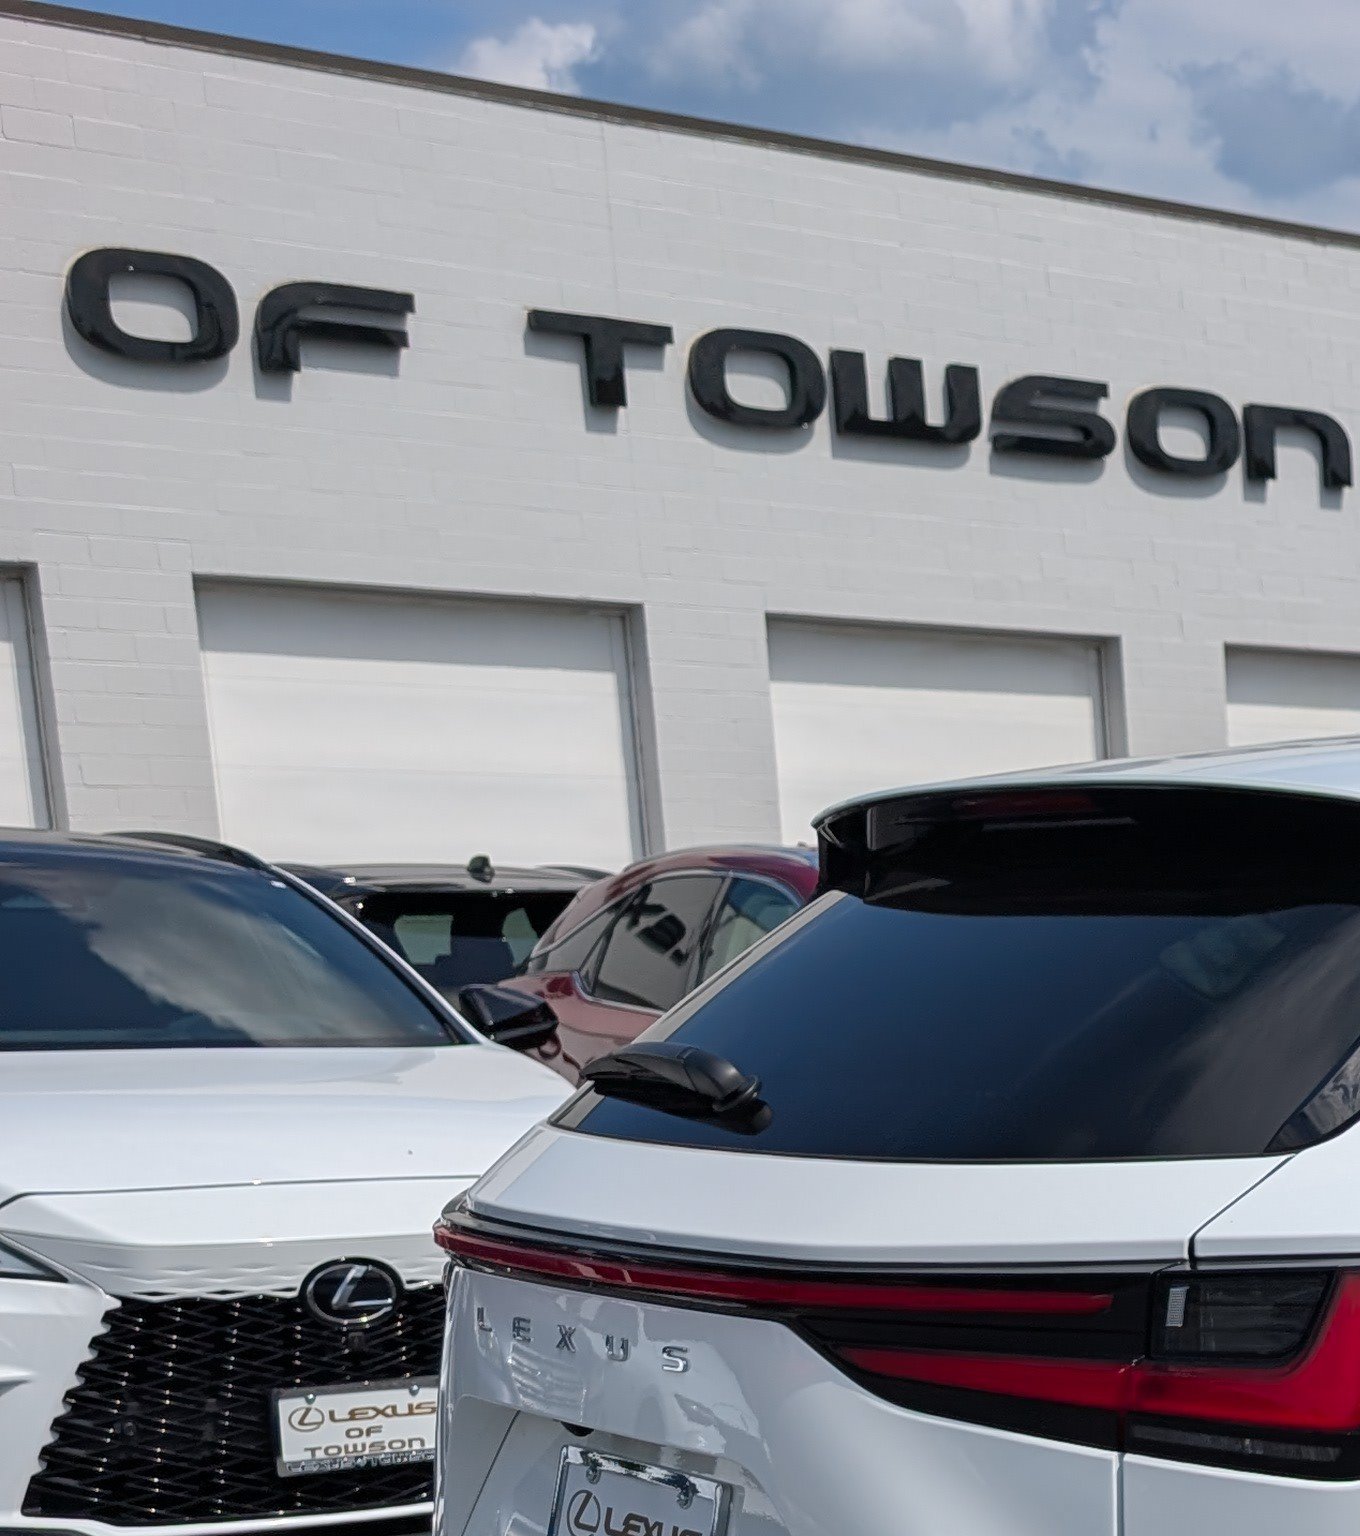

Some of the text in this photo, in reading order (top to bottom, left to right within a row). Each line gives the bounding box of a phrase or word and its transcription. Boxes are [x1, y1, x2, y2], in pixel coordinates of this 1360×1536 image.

[66, 247, 1353, 489] OF TOWSON
[476, 1306, 690, 1374] LEXUS
[328, 1401, 438, 1423] LEXUS
[344, 1424, 384, 1440] OF
[304, 1436, 426, 1459] TOWSON
